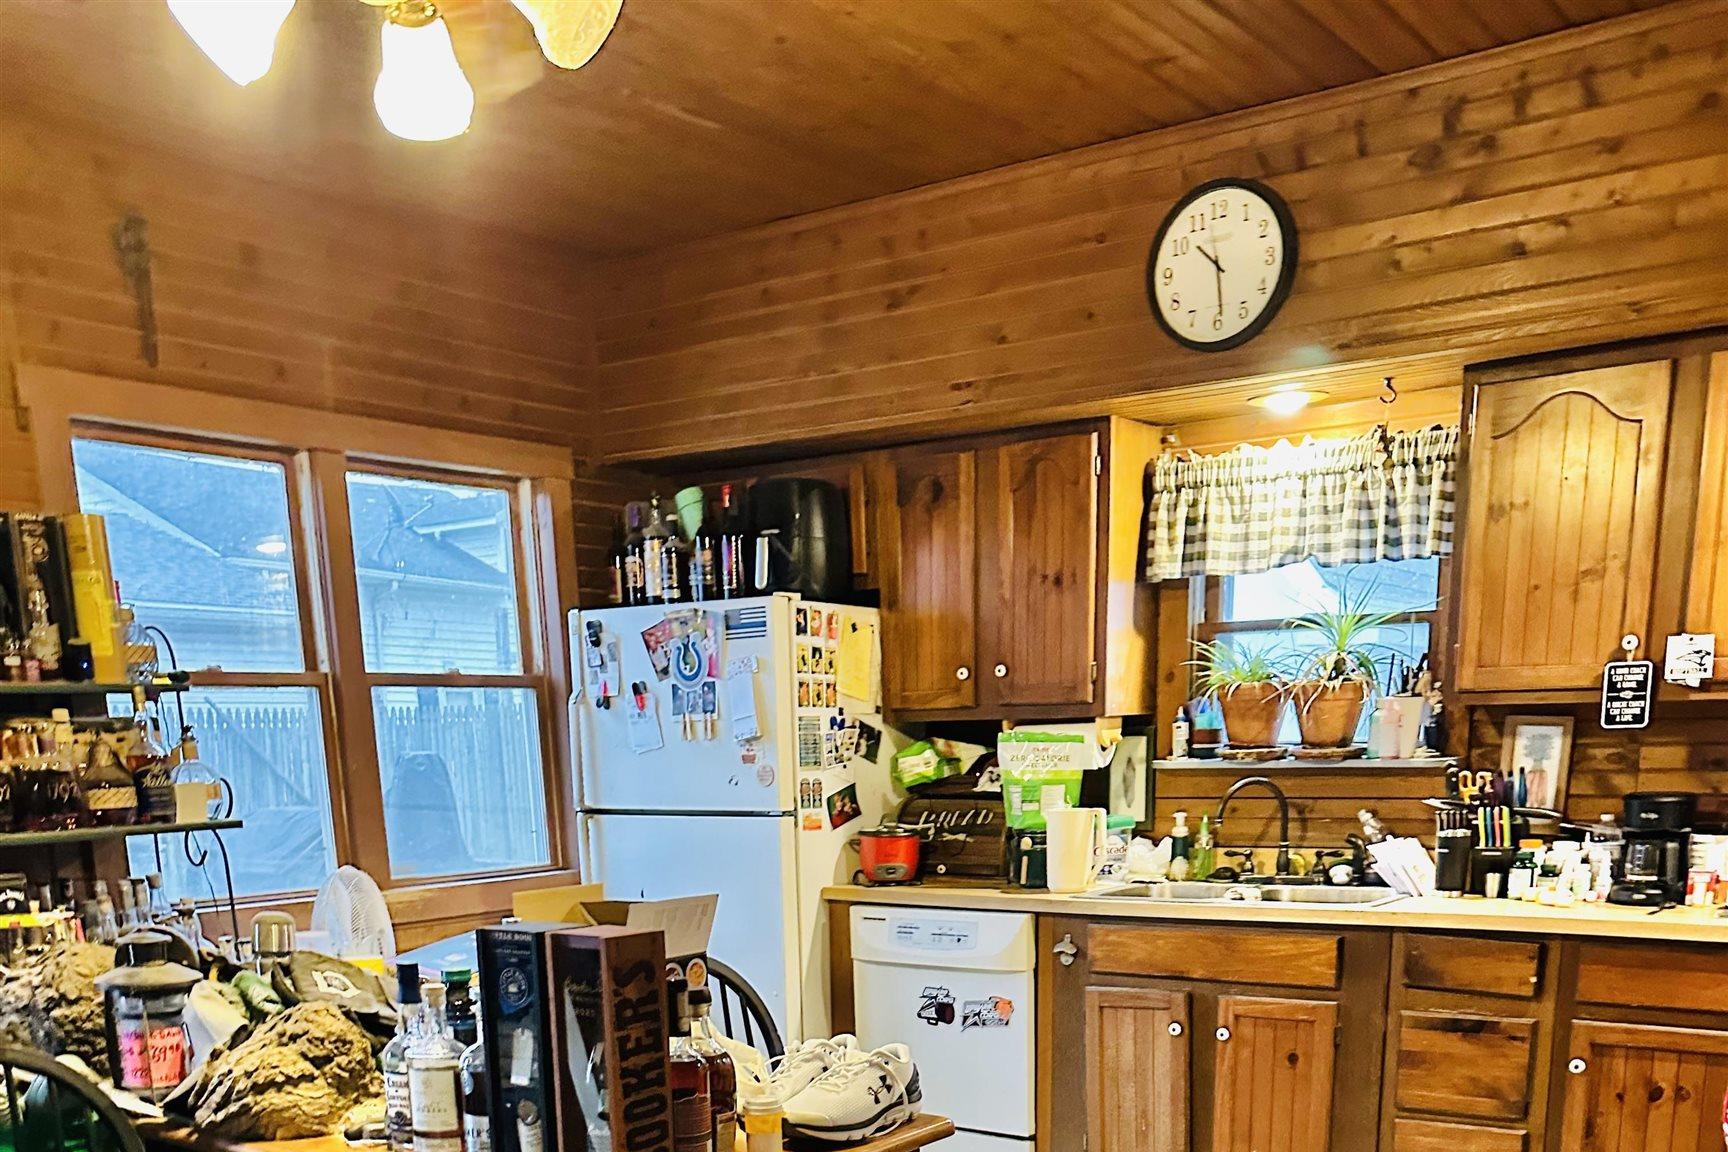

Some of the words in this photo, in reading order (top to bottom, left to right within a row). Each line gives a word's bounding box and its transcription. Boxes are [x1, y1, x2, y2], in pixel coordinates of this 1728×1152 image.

[1210, 199, 1229, 221] 12
[1242, 203, 1250, 222] 1
[1189, 213, 1206, 233] 11
[1258, 219, 1269, 239] 2
[1171, 236, 1190, 257] 10
[1264, 246, 1276, 266] 3
[1163, 267, 1173, 286] 9
[1257, 276, 1268, 295] 4
[1170, 292, 1181, 311] 8
[1238, 300, 1249, 320] 5
[1187, 309, 1197, 328] 7
[1212, 312, 1223, 331] 6
